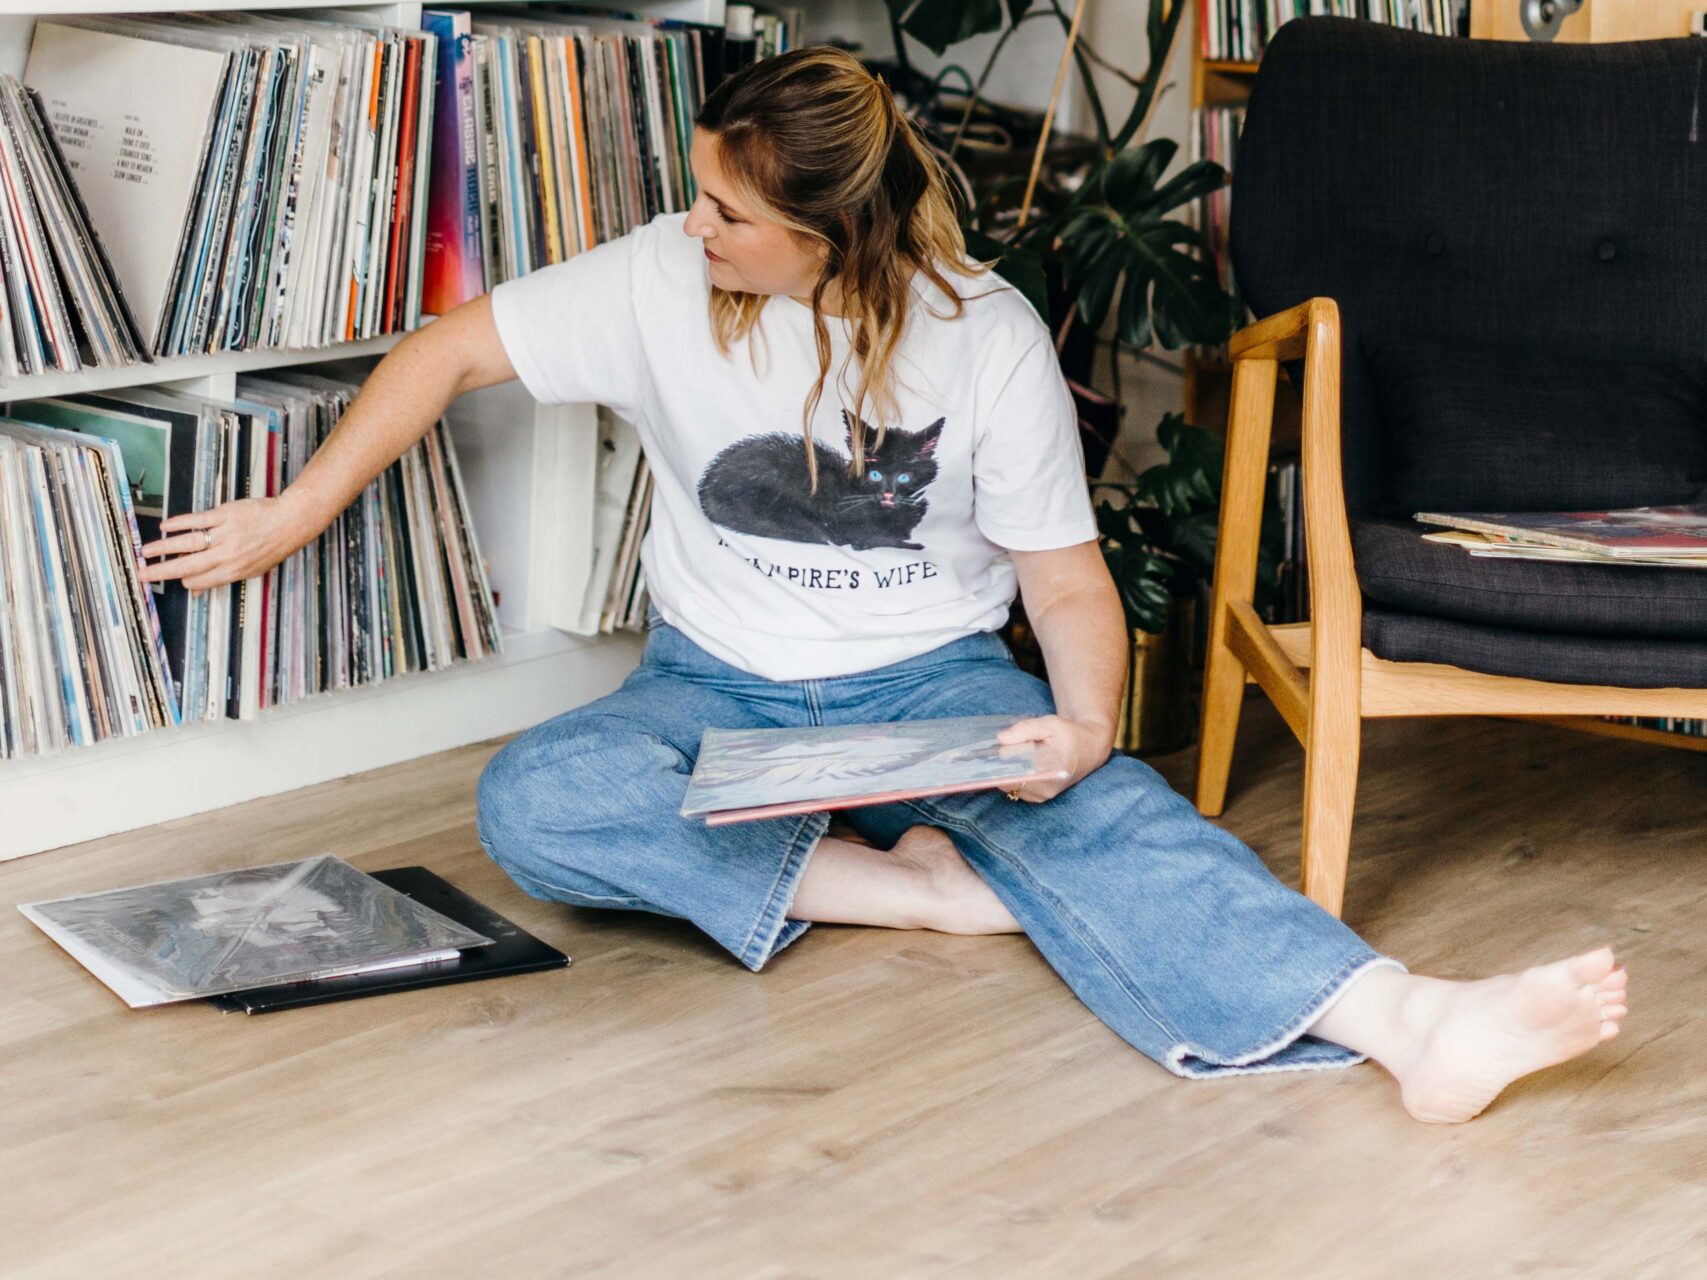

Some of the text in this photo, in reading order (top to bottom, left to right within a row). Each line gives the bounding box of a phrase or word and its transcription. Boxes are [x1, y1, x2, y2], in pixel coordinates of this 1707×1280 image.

[463, 95, 476, 165] CLASSIC
[486, 134, 496, 165] ALBUM
[467, 167, 479, 213] ROCK
[487, 167, 497, 203] COVERS
[745, 557, 938, 590] AMPIRE'S WIFE
